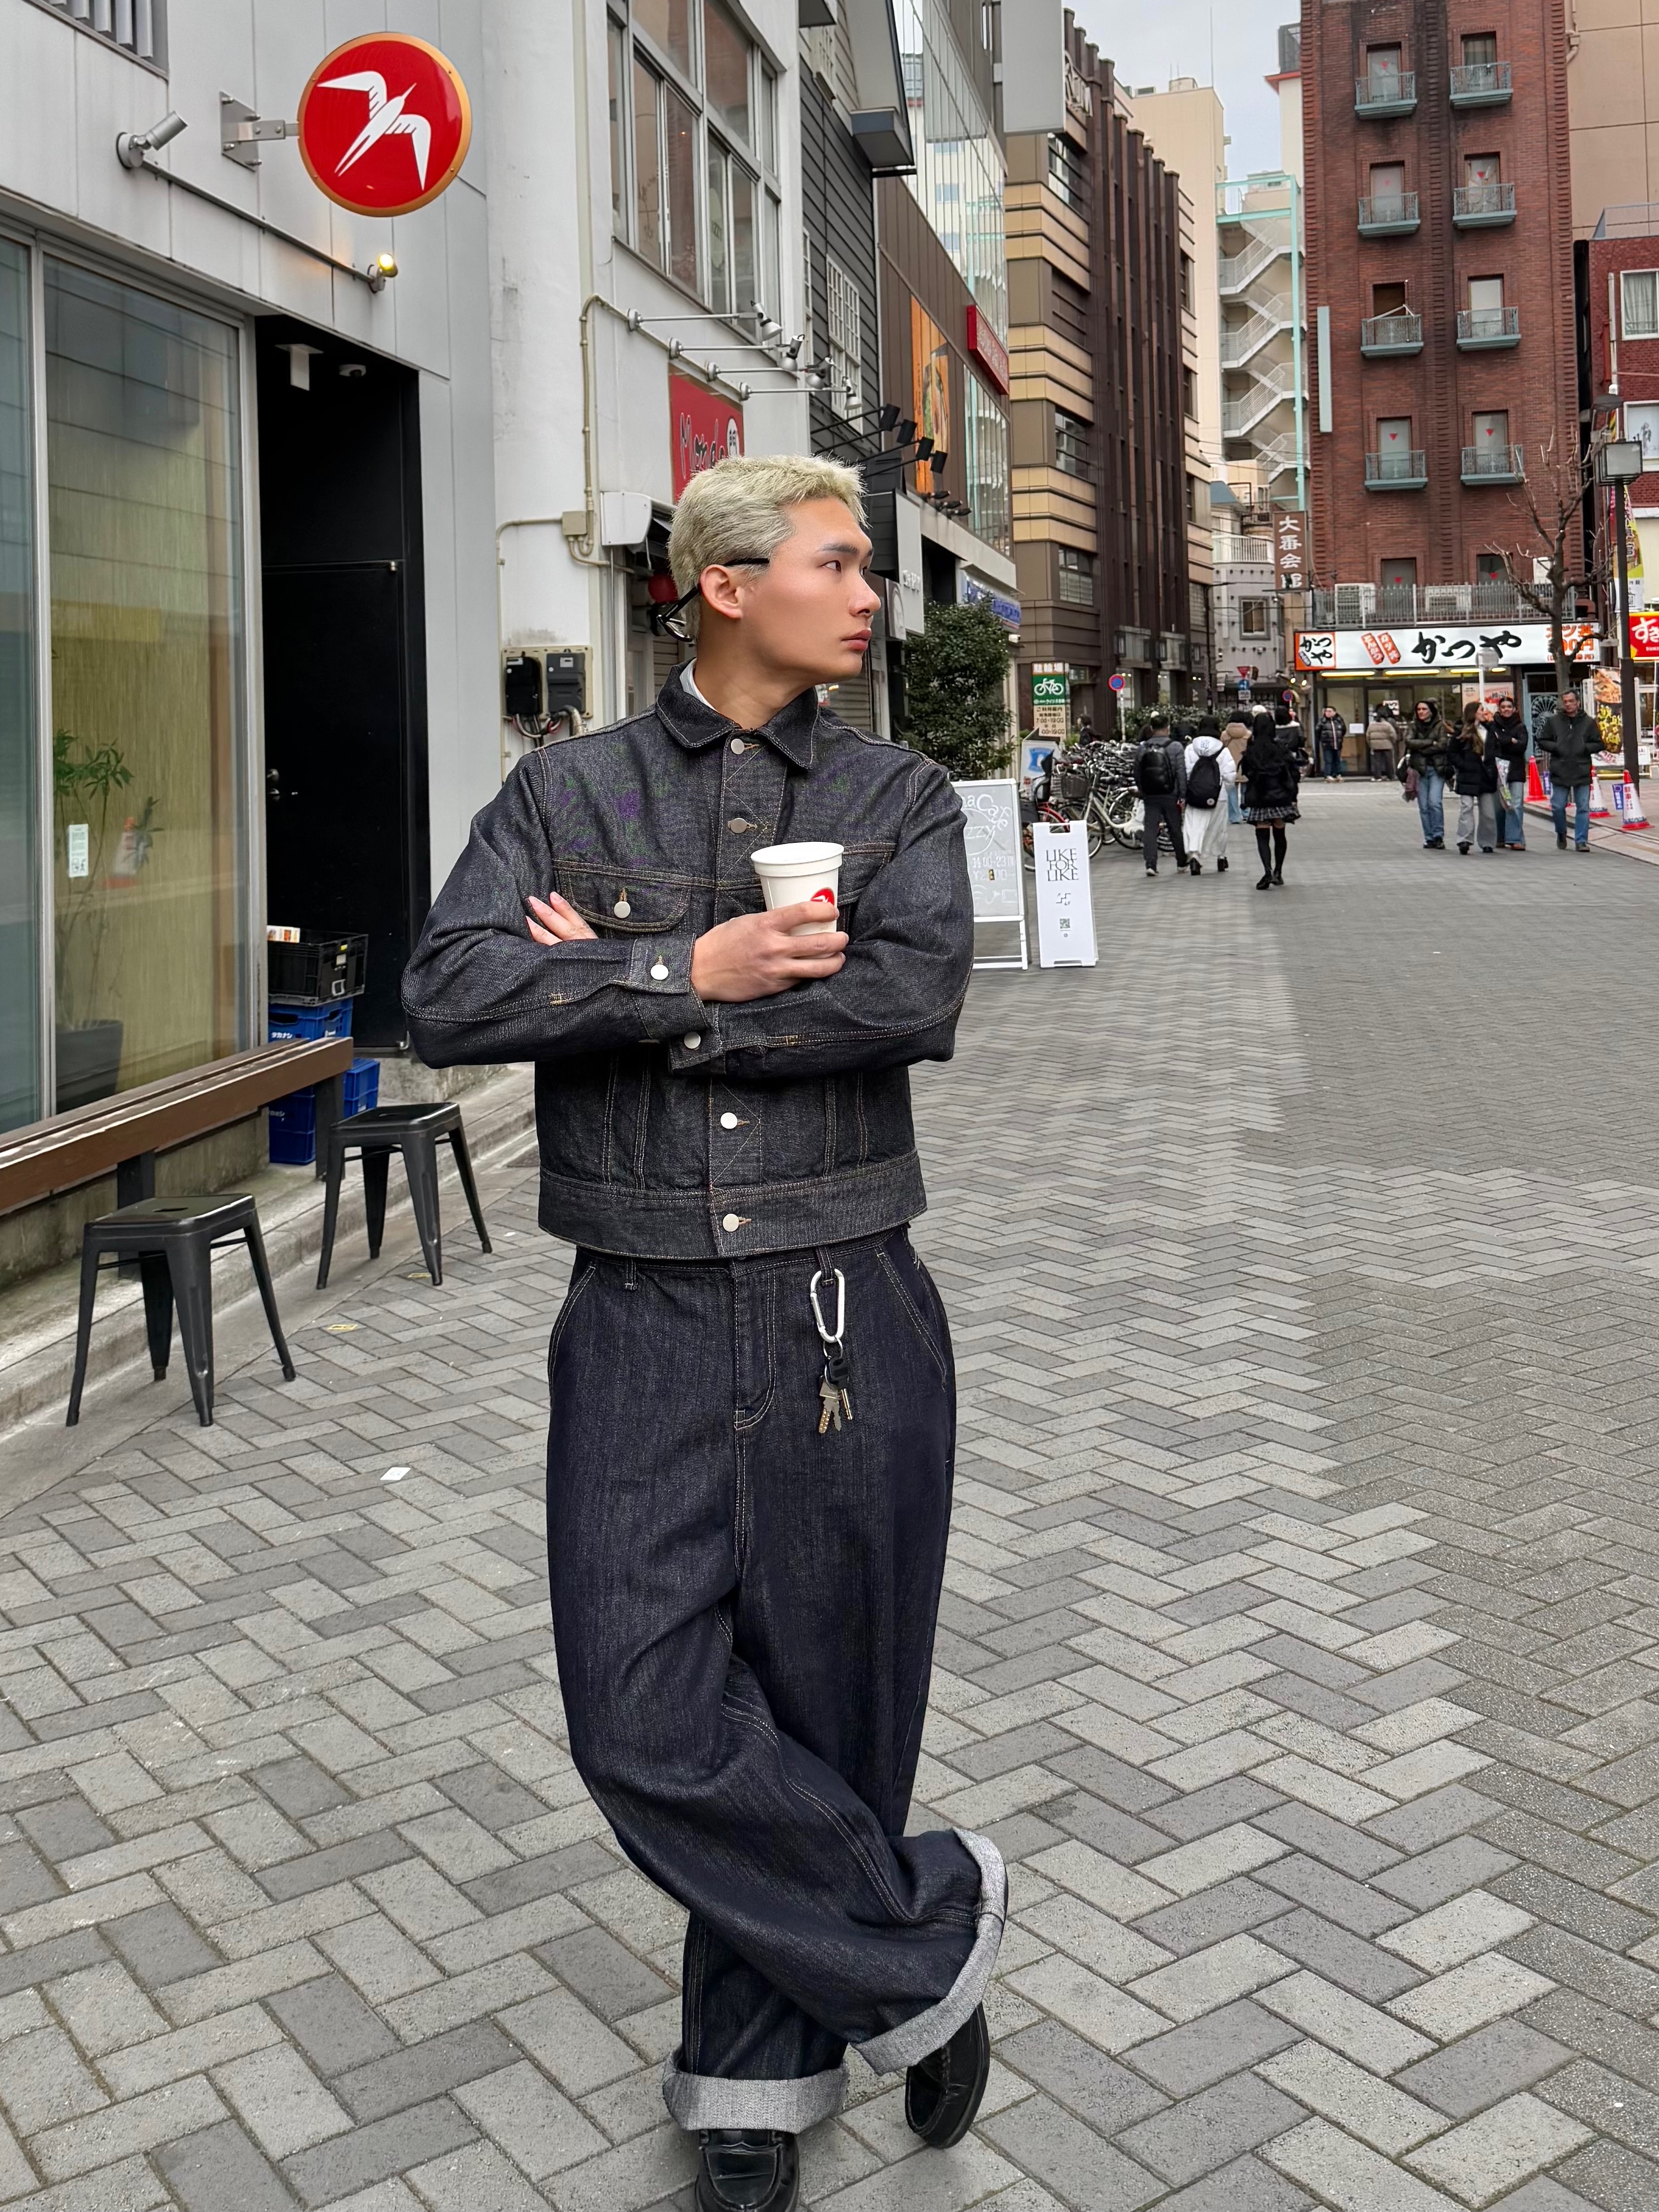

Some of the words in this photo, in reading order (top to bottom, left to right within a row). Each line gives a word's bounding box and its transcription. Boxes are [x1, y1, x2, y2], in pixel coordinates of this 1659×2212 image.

[1411, 630, 1522, 664] かつや
[1046, 848, 1077, 861] LIKE
[1049, 859, 1078, 870] FOR
[1047, 869, 1079, 881] LIKE
